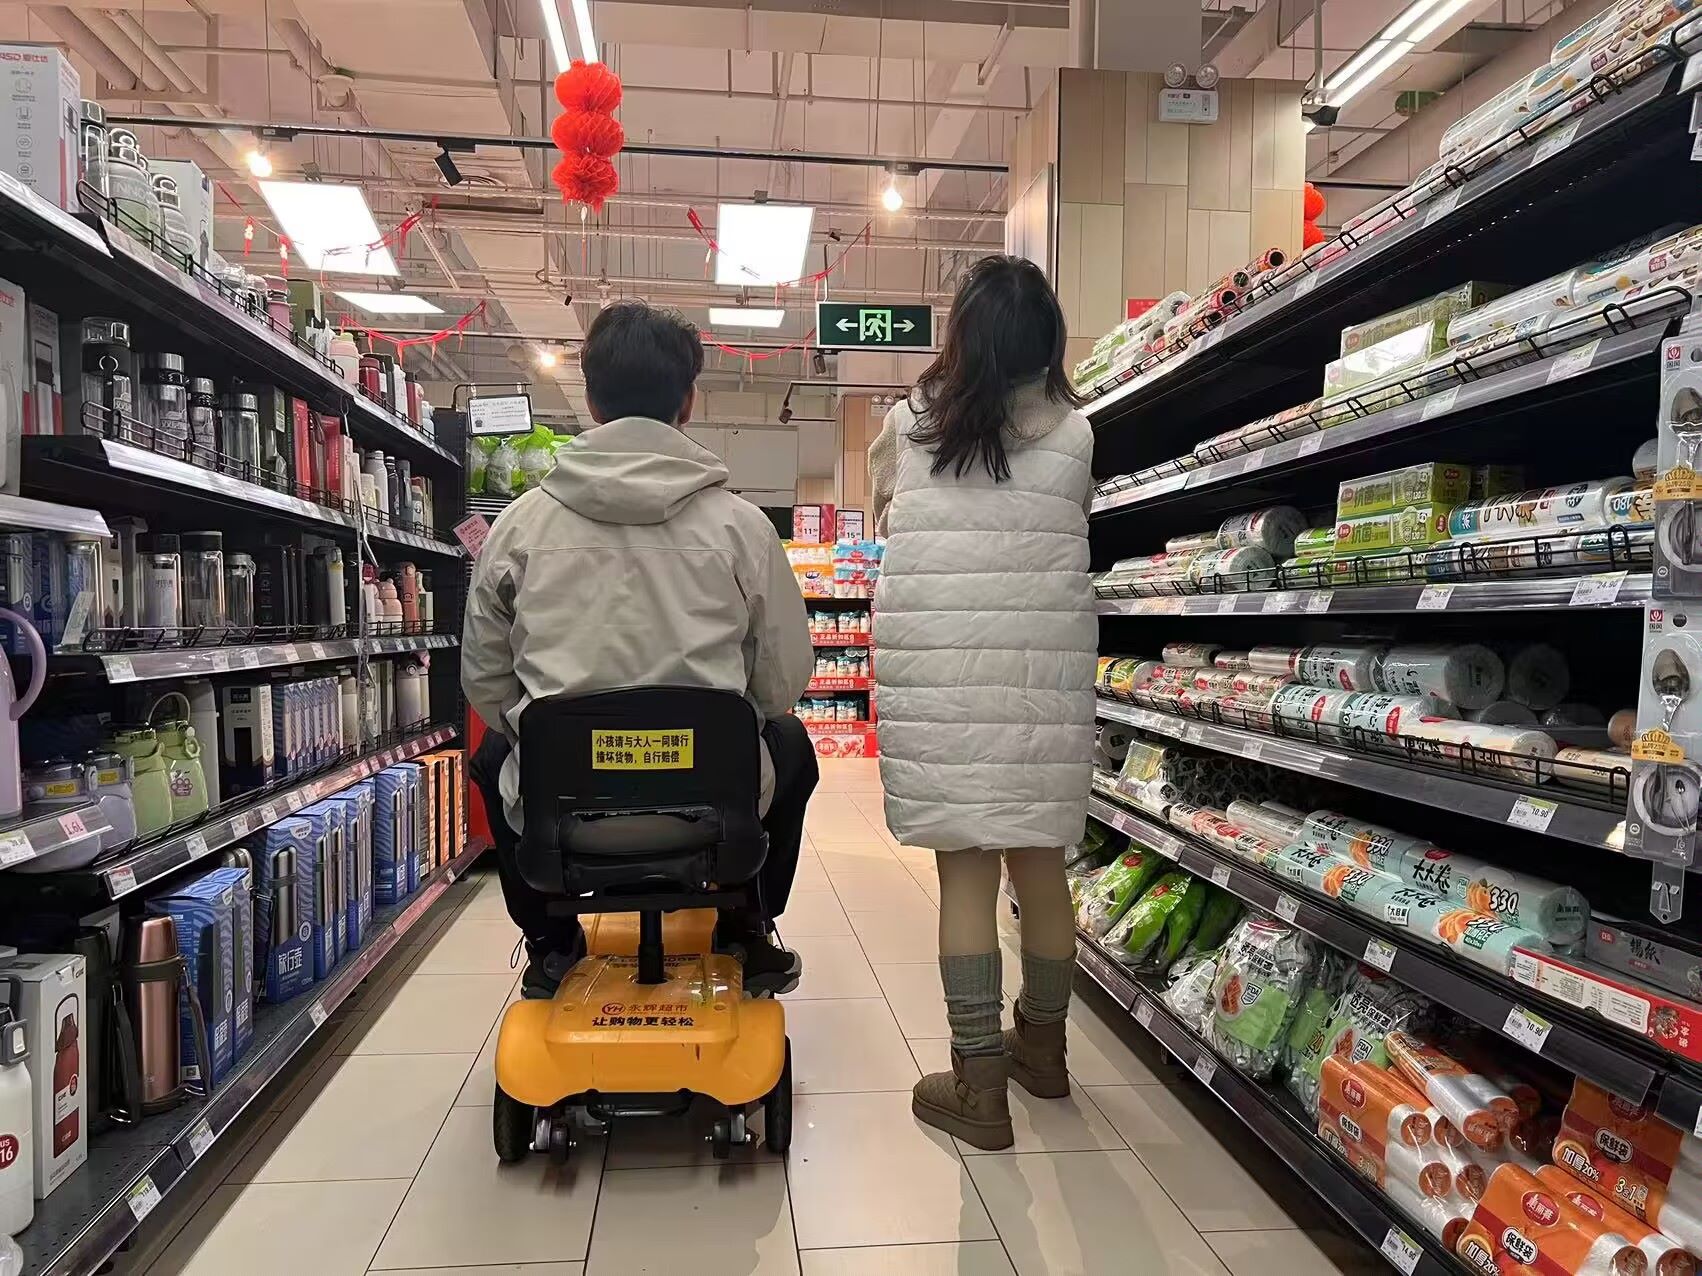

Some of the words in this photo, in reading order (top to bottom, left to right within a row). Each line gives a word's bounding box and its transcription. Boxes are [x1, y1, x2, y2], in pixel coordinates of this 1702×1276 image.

[597, 735, 689, 748] 小孩请与大人一同骑行
[1489, 886, 1519, 916] 330
[279, 947, 303, 975] 旅行壶
[629, 1003, 688, 1012] 永辉超市
[592, 1016, 694, 1027] 让购物更轻松
[1358, 1041, 1370, 1053] FDA
[1600, 1132, 1629, 1158] 保鲜袋
[1505, 1231, 1534, 1260] 保鲜袋
